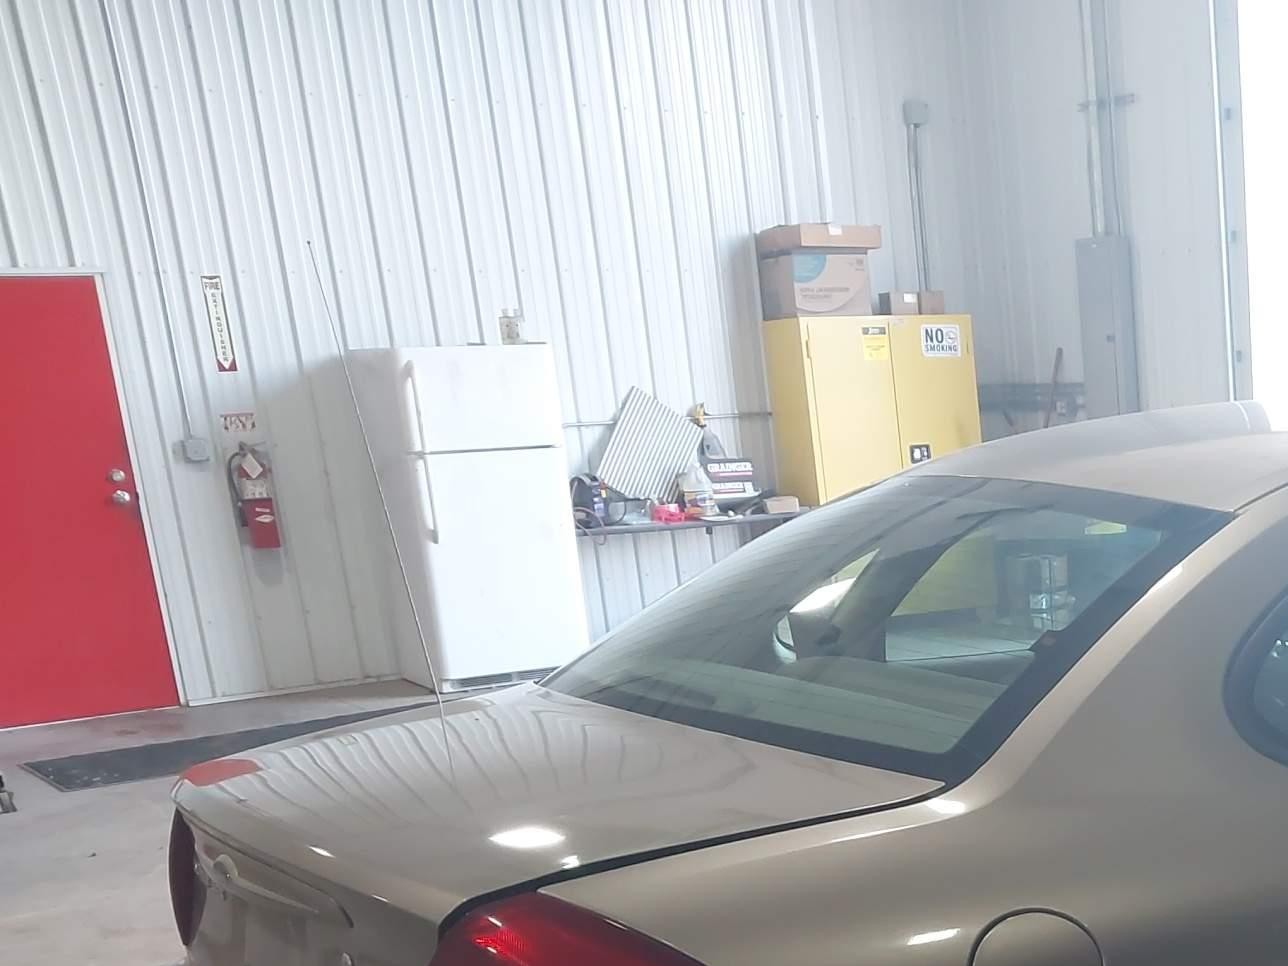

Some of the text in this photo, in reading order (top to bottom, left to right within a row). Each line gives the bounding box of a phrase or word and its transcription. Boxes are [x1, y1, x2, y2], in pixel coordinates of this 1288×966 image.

[204, 281, 220, 290] FIRE
[925, 328, 944, 344] NO
[925, 344, 957, 353] SMOKING
